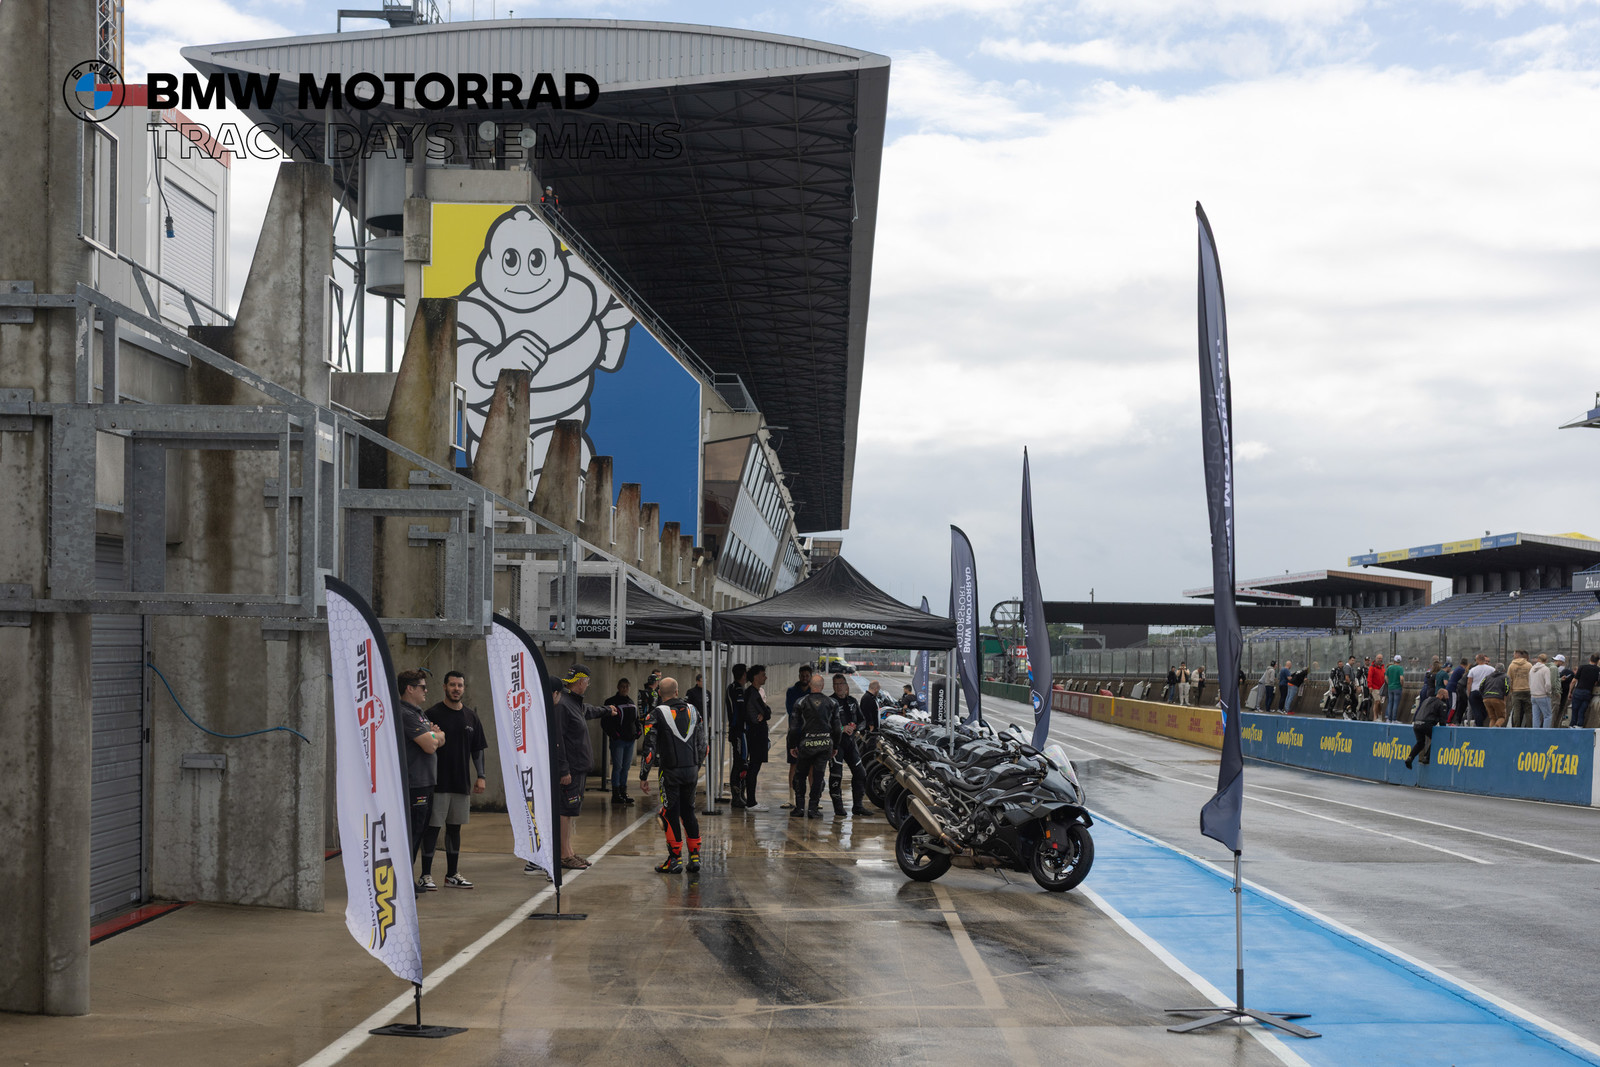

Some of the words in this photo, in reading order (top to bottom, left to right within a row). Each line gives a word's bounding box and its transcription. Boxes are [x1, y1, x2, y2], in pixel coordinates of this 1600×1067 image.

[822, 621, 841, 629] BMW
[844, 622, 888, 631] MOTORRAD
[822, 628, 875, 637] MOTORSPORT
[1277, 728, 1304, 749] GOODYEAR
[1320, 732, 1352, 756] GOODYEAR
[1373, 737, 1412, 764] GOODYEAR
[1437, 741, 1486, 773] GOODYEAR
[1517, 744, 1579, 781] GOODYEAR
